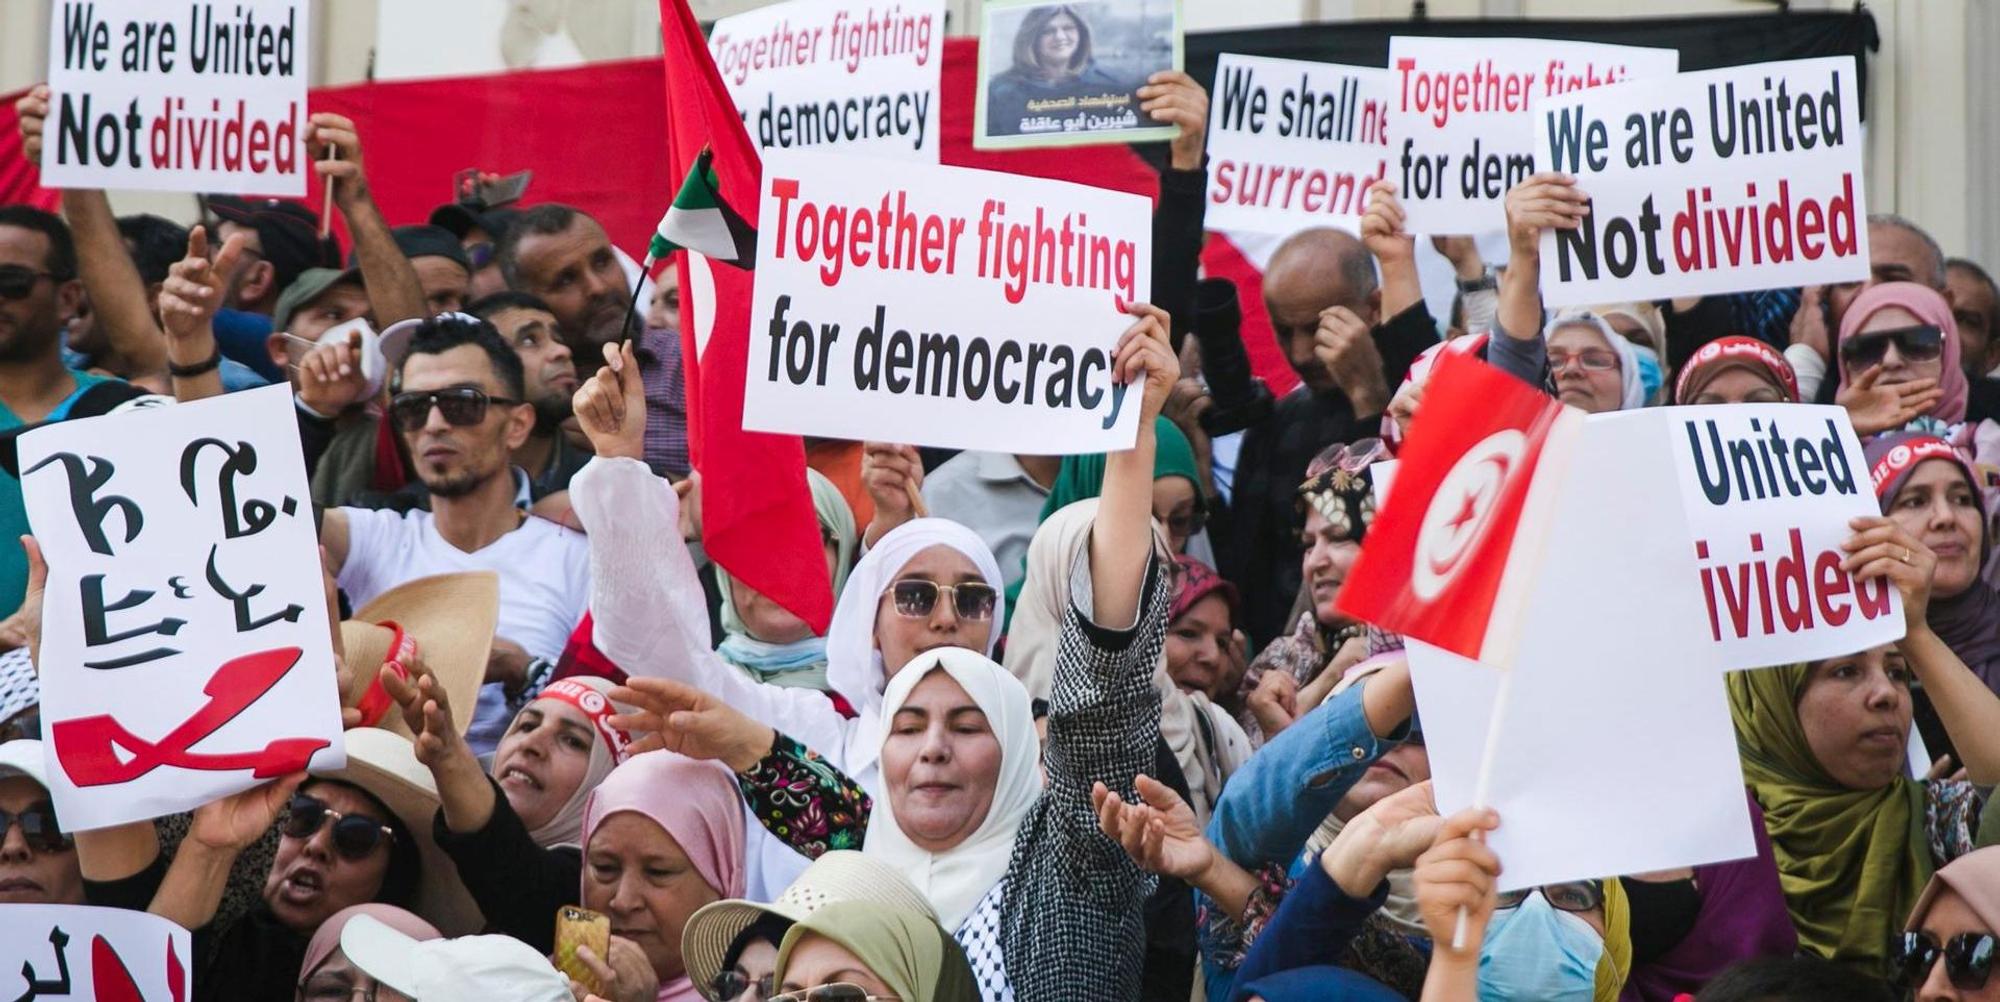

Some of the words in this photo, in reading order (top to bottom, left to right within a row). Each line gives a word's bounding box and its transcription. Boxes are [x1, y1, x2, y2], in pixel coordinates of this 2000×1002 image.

[64, 3, 109, 72] We
[121, 22, 176, 74] are
[190, 4, 295, 77] United
[714, 20, 822, 86] Together
[830, 4, 931, 74] fighting
[57, 93, 142, 169] Not
[149, 96, 297, 175] divided
[759, 92, 929, 150] democracy
[1020, 117, 1062, 133] عاقلة
[1087, 110, 1136, 129] شيرين
[1221, 65, 1267, 134] We
[1279, 72, 1358, 142] shall
[1396, 57, 1534, 129] Together
[1547, 105, 1609, 175] We
[1625, 108, 1694, 169] are
[1708, 71, 1844, 159] United
[1401, 139, 1449, 200] for
[770, 176, 967, 288] Together
[977, 199, 1136, 315] fighting
[1554, 194, 1666, 283] Not
[1672, 173, 1857, 272] divided
[768, 295, 841, 386] for
[853, 305, 1129, 430] democracy
[1685, 418, 1858, 506] United
[179, 437, 305, 633] لرفع
[50, 645, 330, 788] لا
